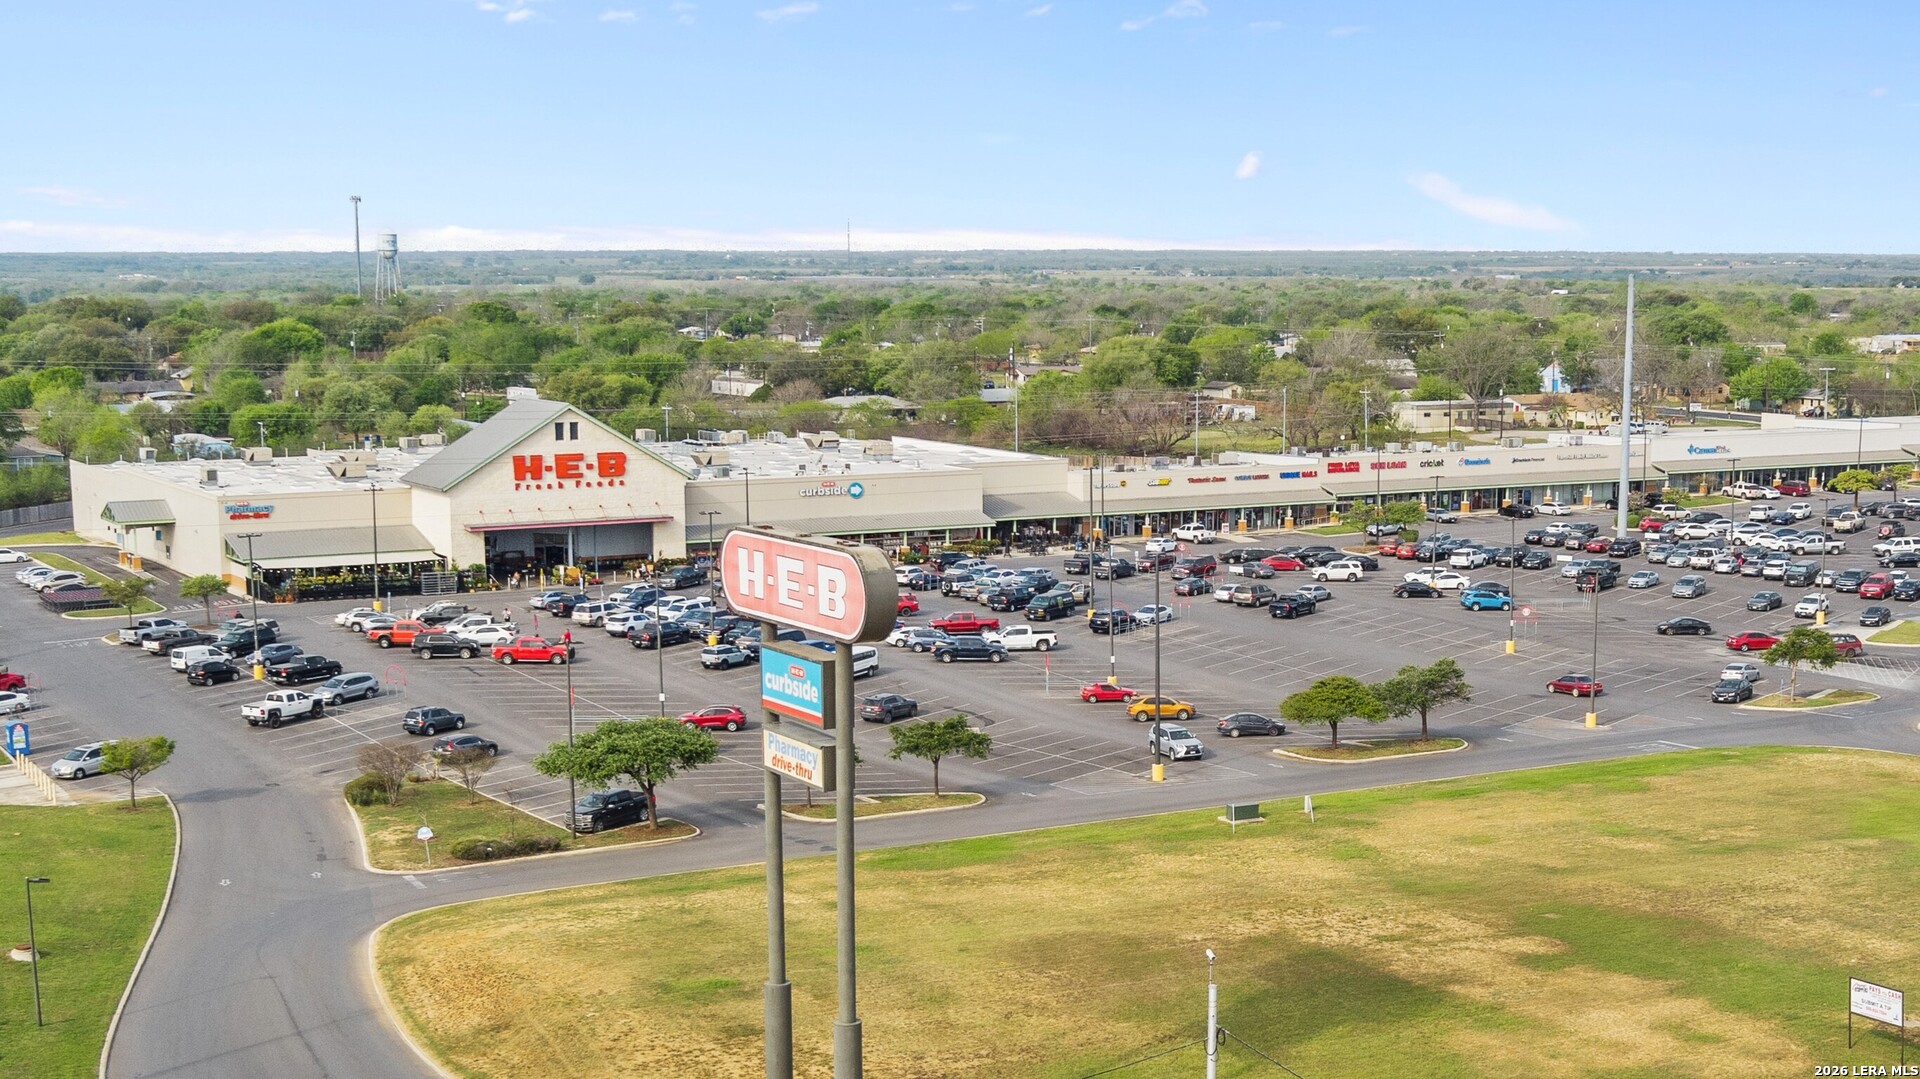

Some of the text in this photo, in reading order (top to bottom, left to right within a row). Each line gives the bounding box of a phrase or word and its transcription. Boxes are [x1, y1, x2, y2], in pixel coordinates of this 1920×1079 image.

[514, 478, 625, 491] Fresh Foods
[799, 486, 848, 497] curbside
[765, 671, 819, 703] curbside
[768, 732, 818, 770] Pharmacy
